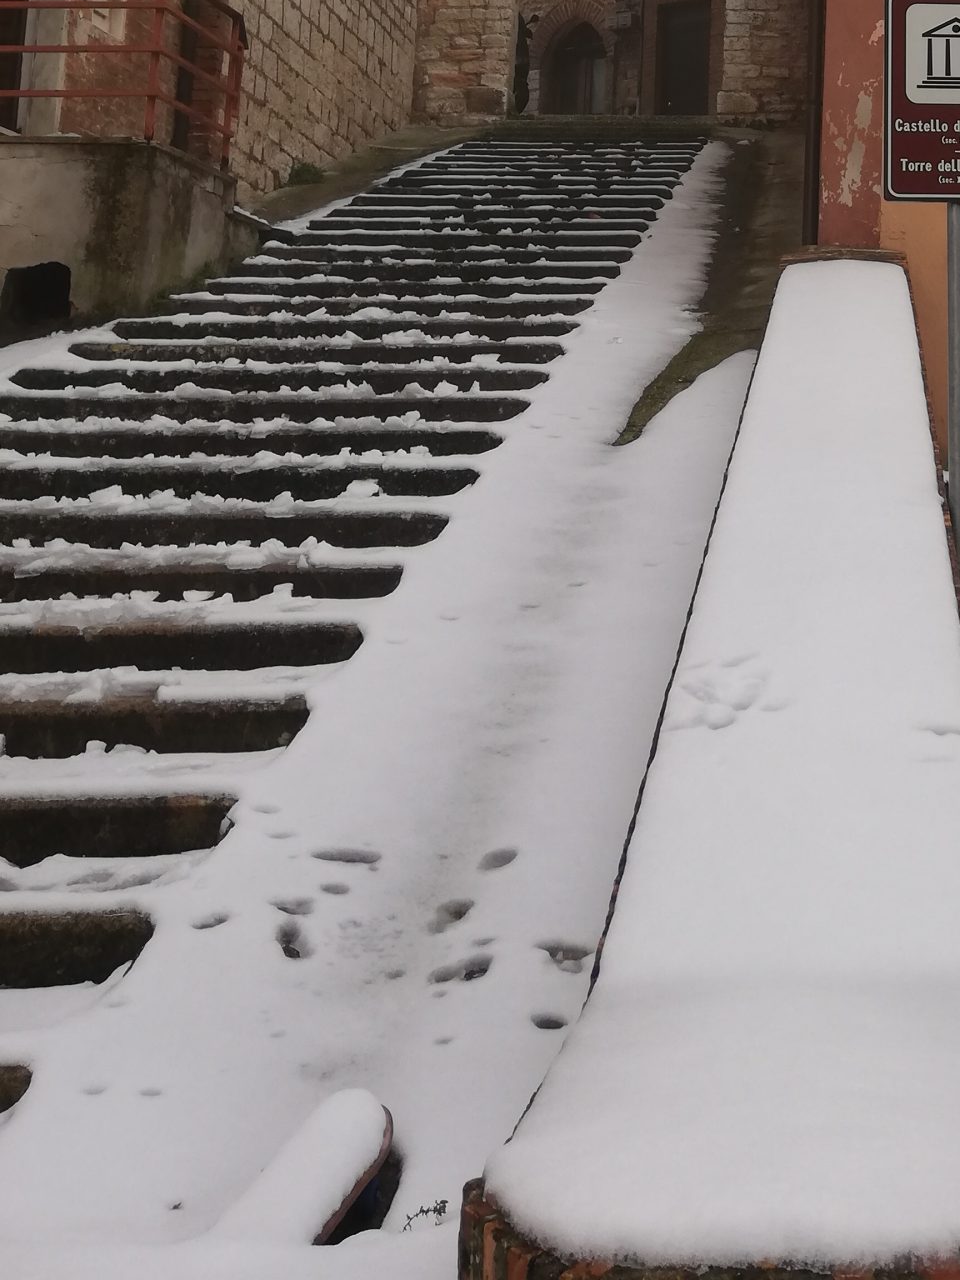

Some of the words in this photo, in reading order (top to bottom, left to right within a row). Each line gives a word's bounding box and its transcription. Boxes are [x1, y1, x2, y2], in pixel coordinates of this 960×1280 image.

[894, 118, 949, 132] Castello
[941, 136, 958, 145] (sec.
[900, 158, 933, 172] Torre
[938, 175, 955, 184] (sec.
